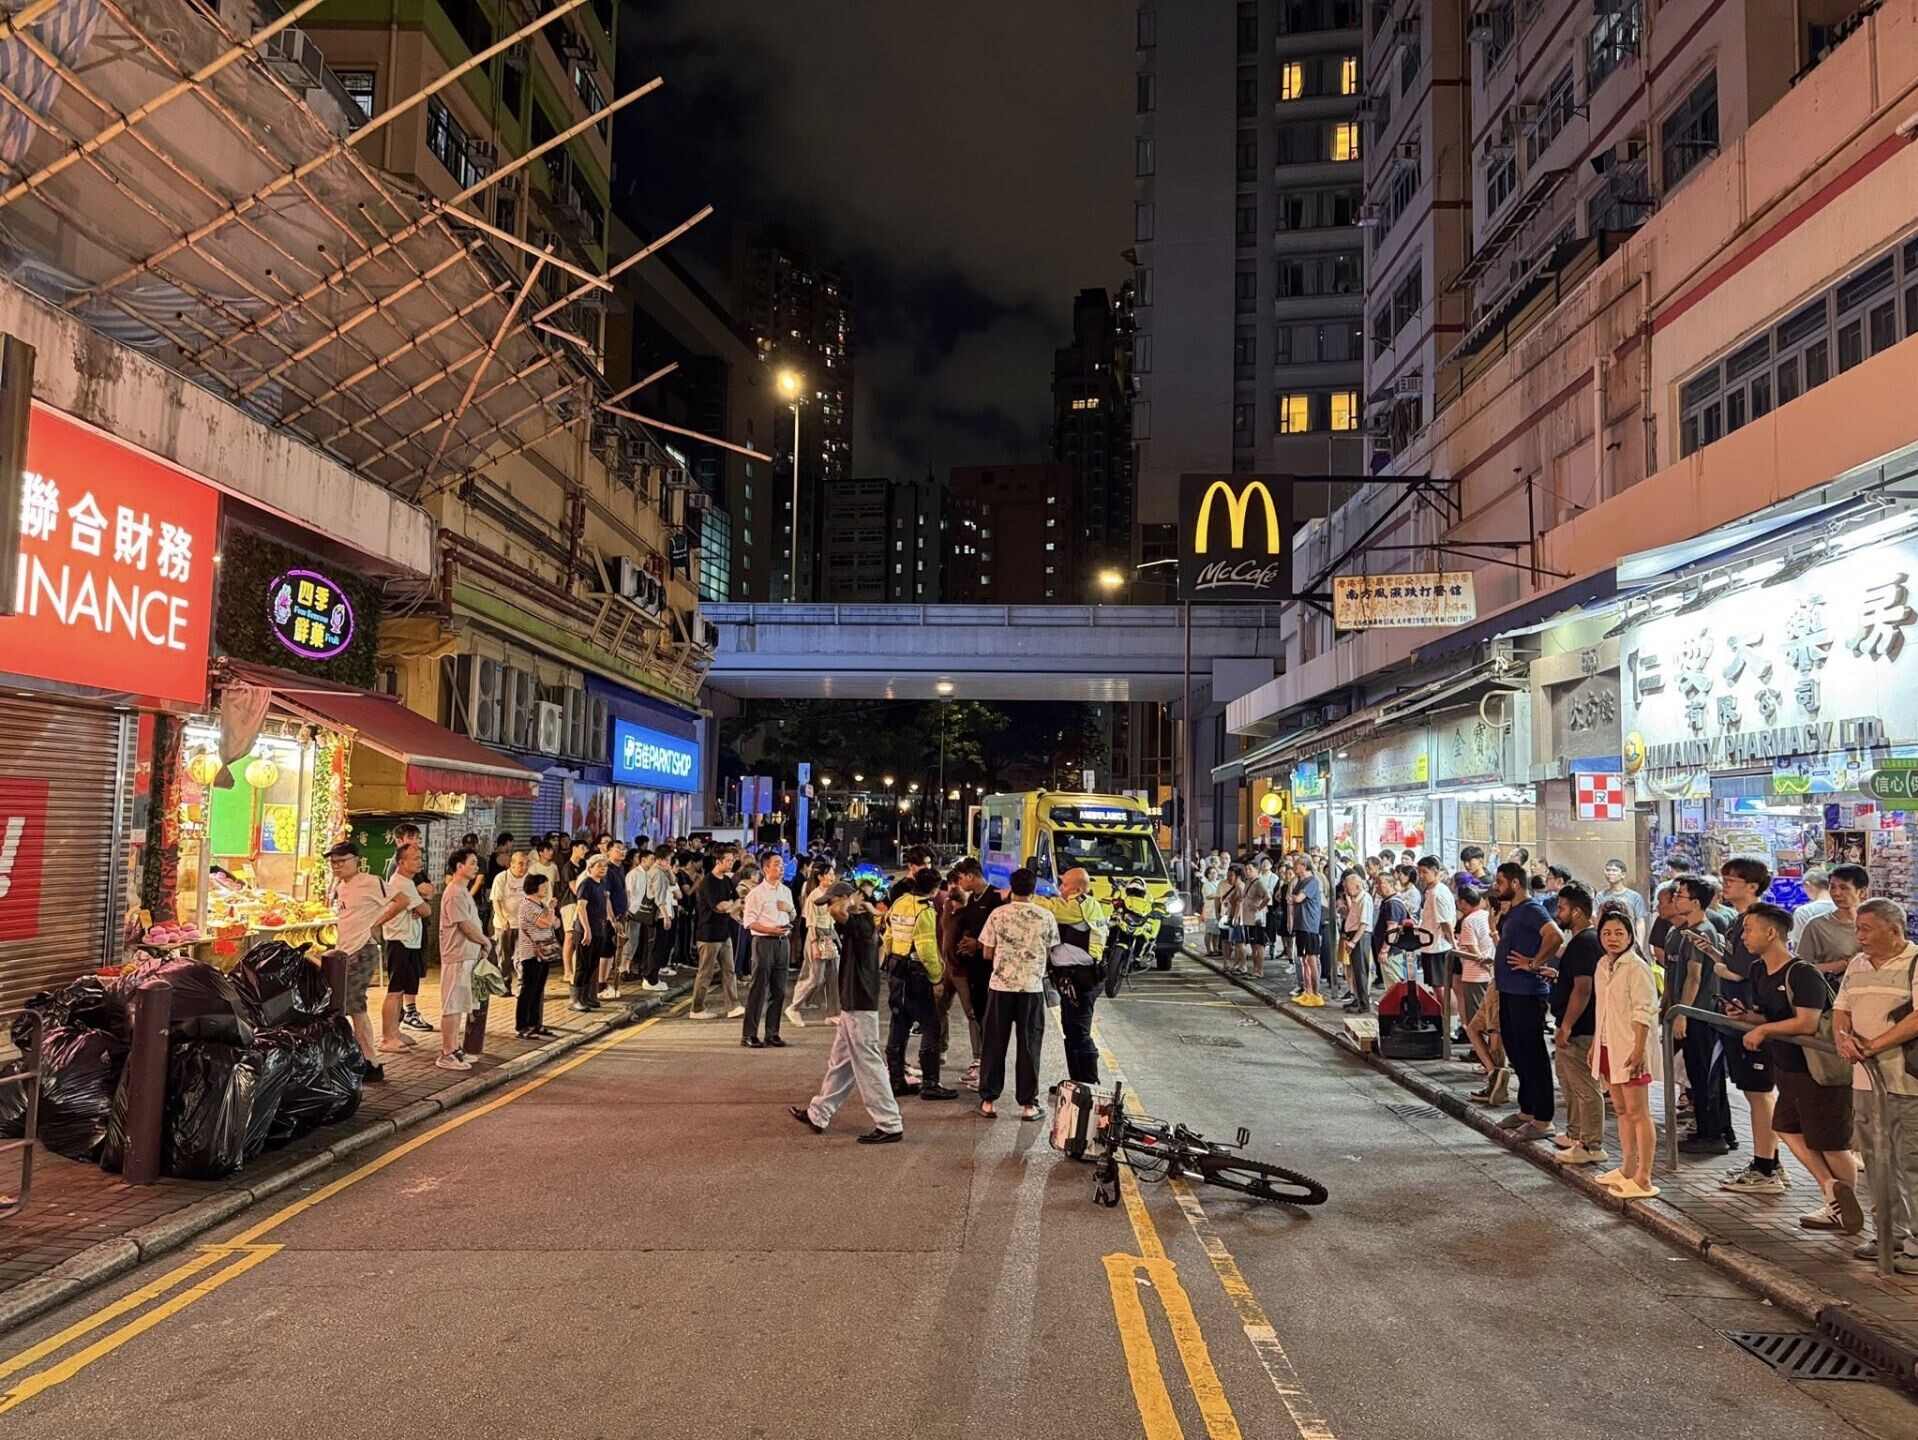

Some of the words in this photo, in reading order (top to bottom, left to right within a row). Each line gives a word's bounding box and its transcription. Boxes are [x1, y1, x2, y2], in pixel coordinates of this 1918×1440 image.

[20, 471, 193, 583] 聯合財務
[1195, 560, 1280, 590] McCafé
[1725, 722, 1833, 760] PHARMACY
[1079, 811, 1128, 821] AMBULANCE
